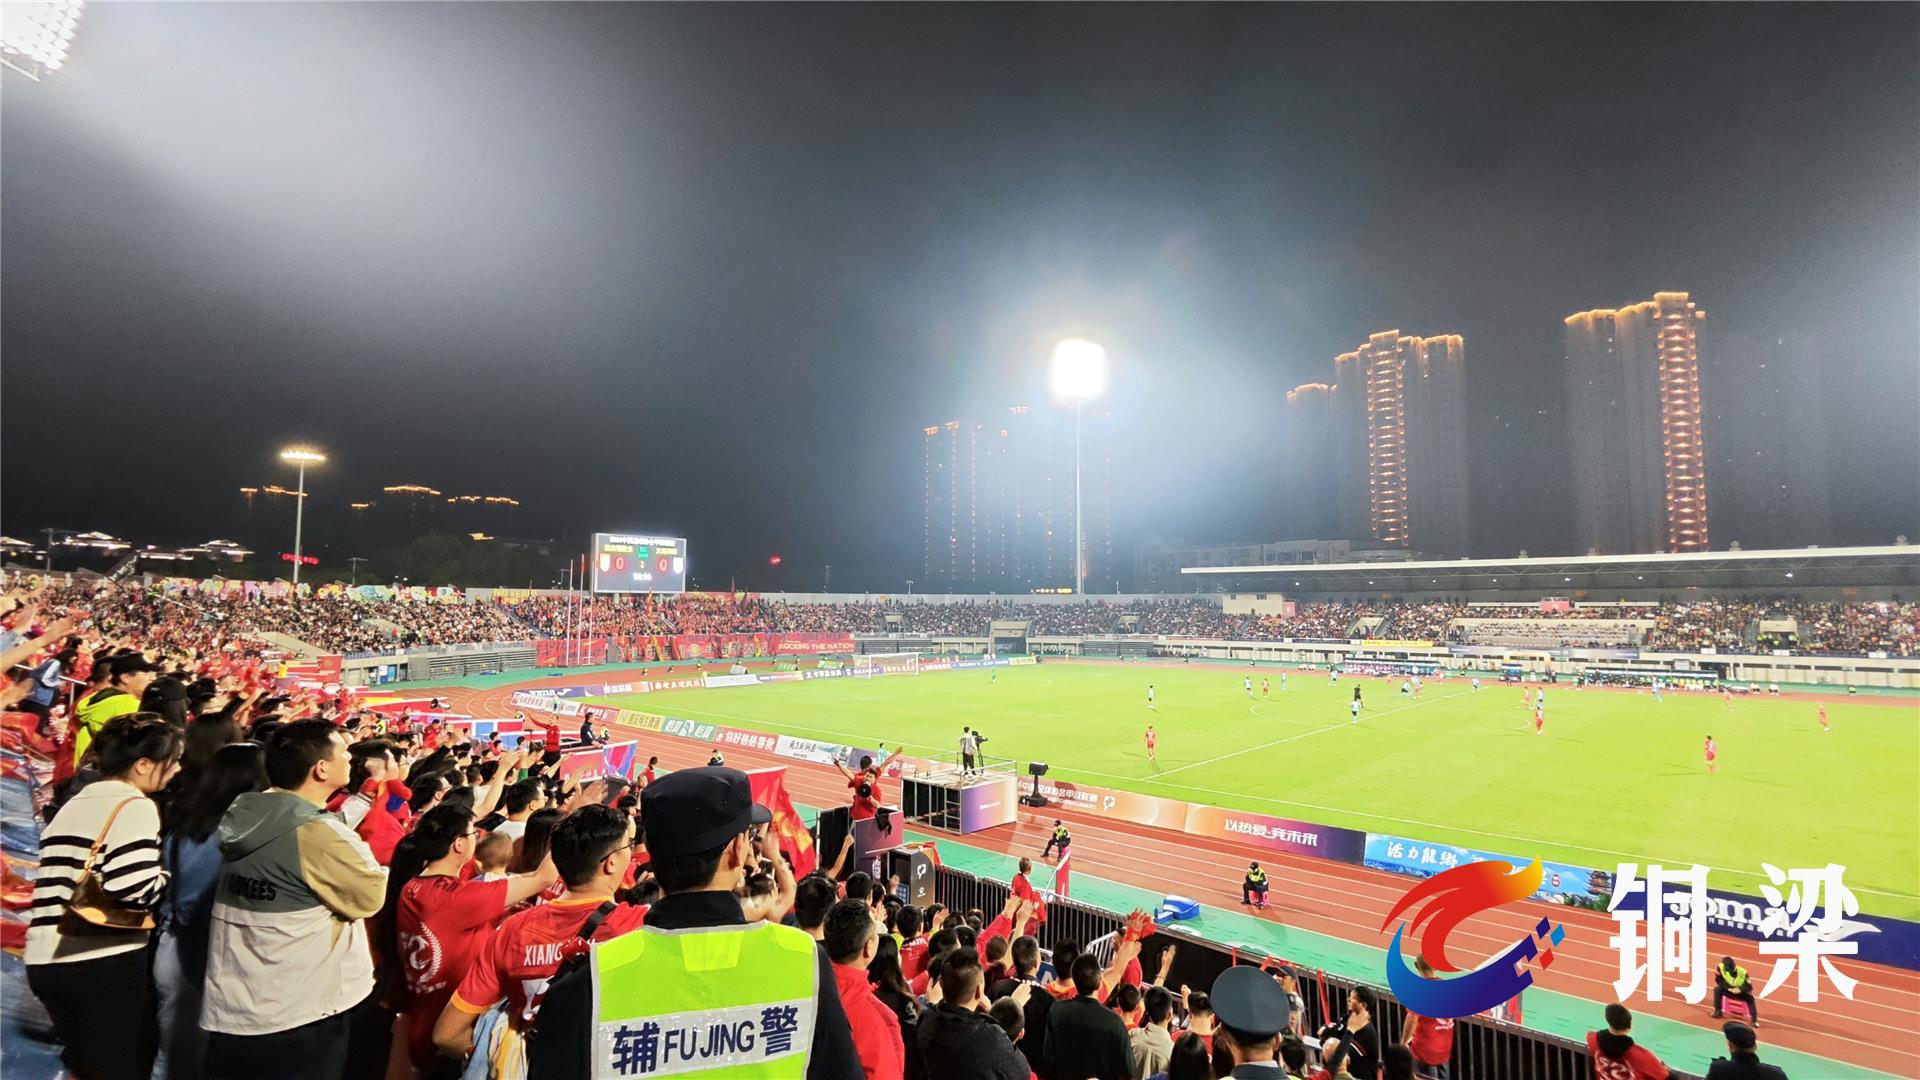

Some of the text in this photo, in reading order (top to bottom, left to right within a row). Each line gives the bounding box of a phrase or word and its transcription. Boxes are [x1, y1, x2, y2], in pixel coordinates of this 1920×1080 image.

[811, 643, 825, 651] THE
[827, 642, 854, 650] NATION
[523, 942, 563, 966] XIANG
[612, 1004, 799, 1075] 辅 FUJING 警
